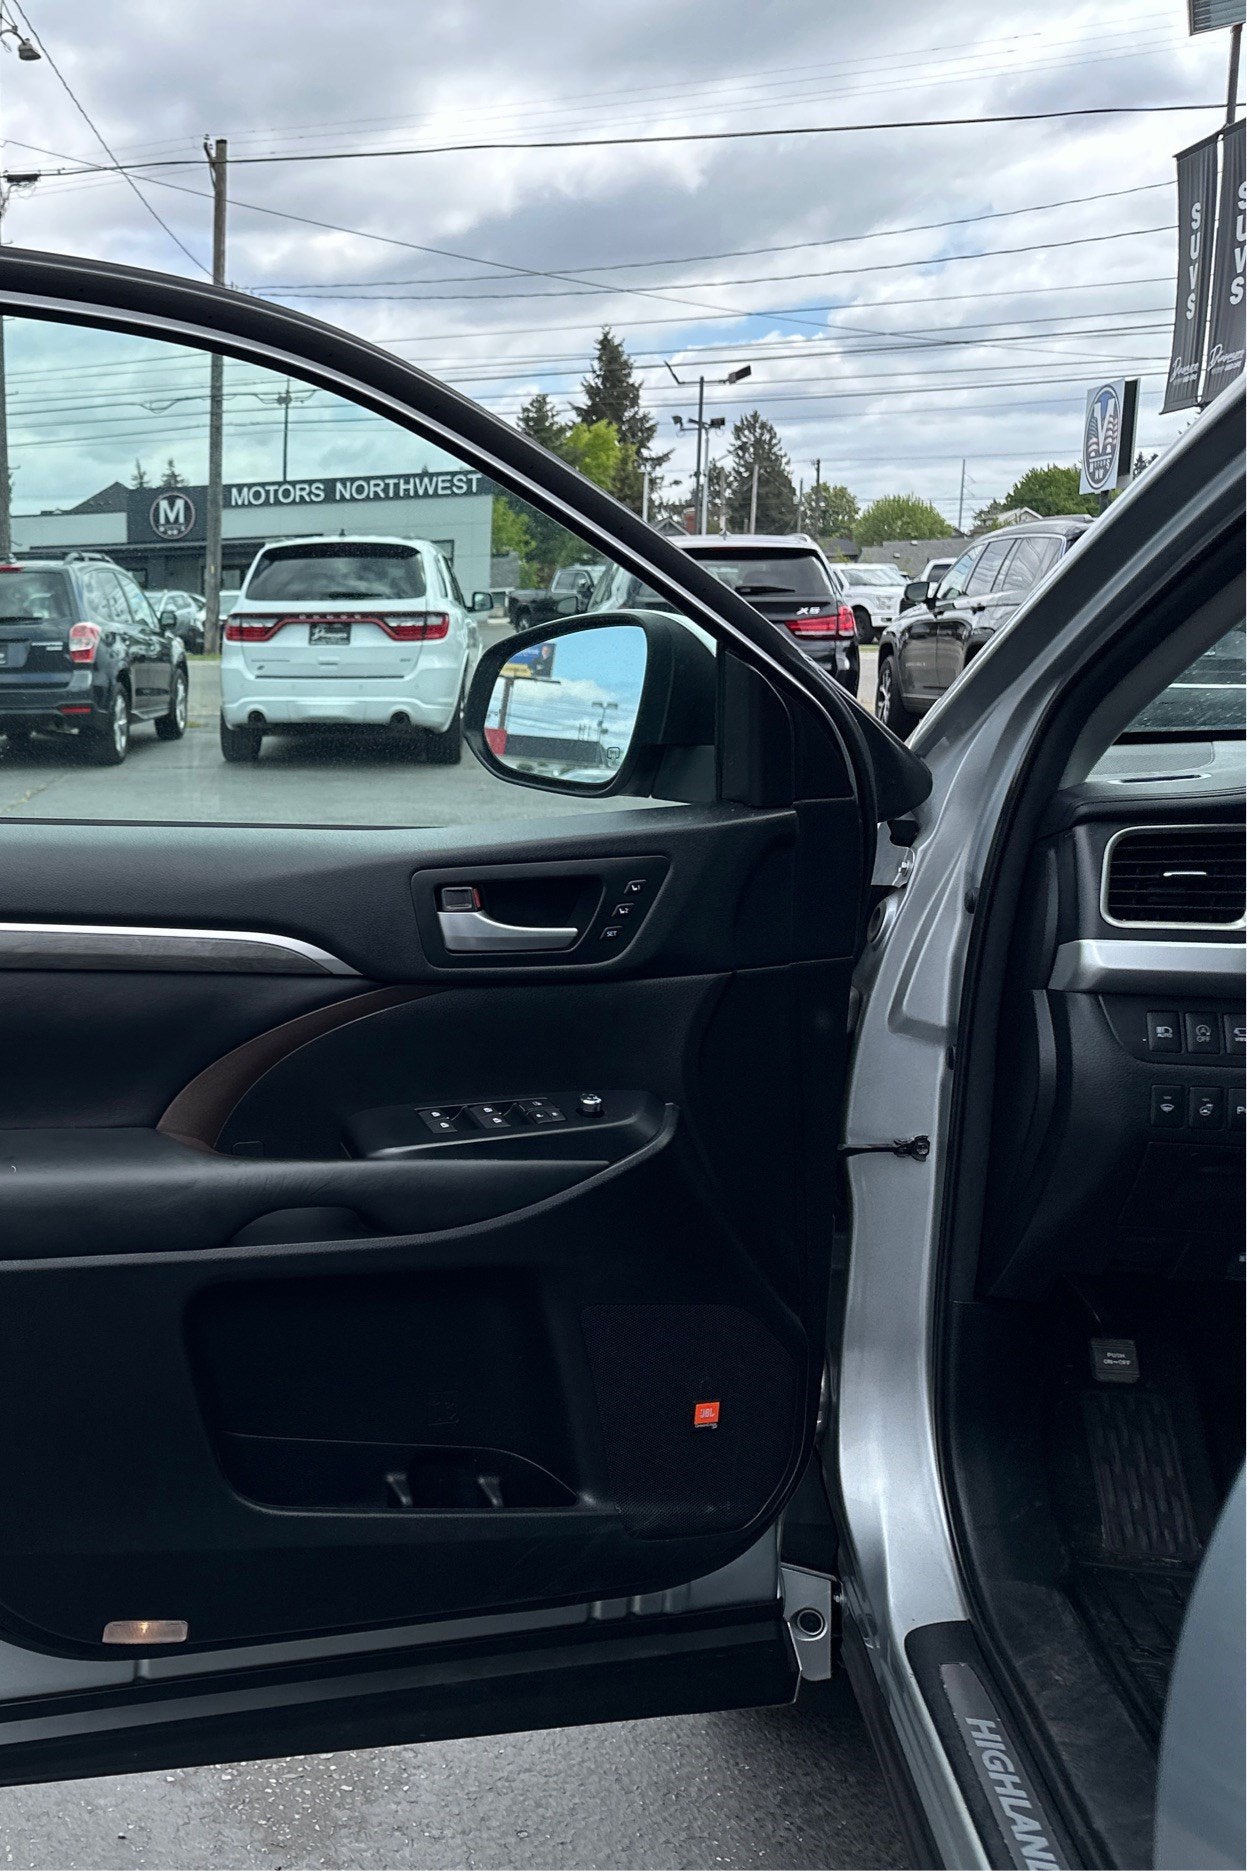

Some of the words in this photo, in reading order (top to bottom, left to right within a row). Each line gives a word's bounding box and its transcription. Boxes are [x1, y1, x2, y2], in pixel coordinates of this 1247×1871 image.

[1186, 202, 1201, 320] SUVS
[231, 483, 325, 506] MOTORS
[335, 473, 483, 501] NORTHWEST
[159, 498, 185, 524] M
[699, 1408, 716, 1419] JBL
